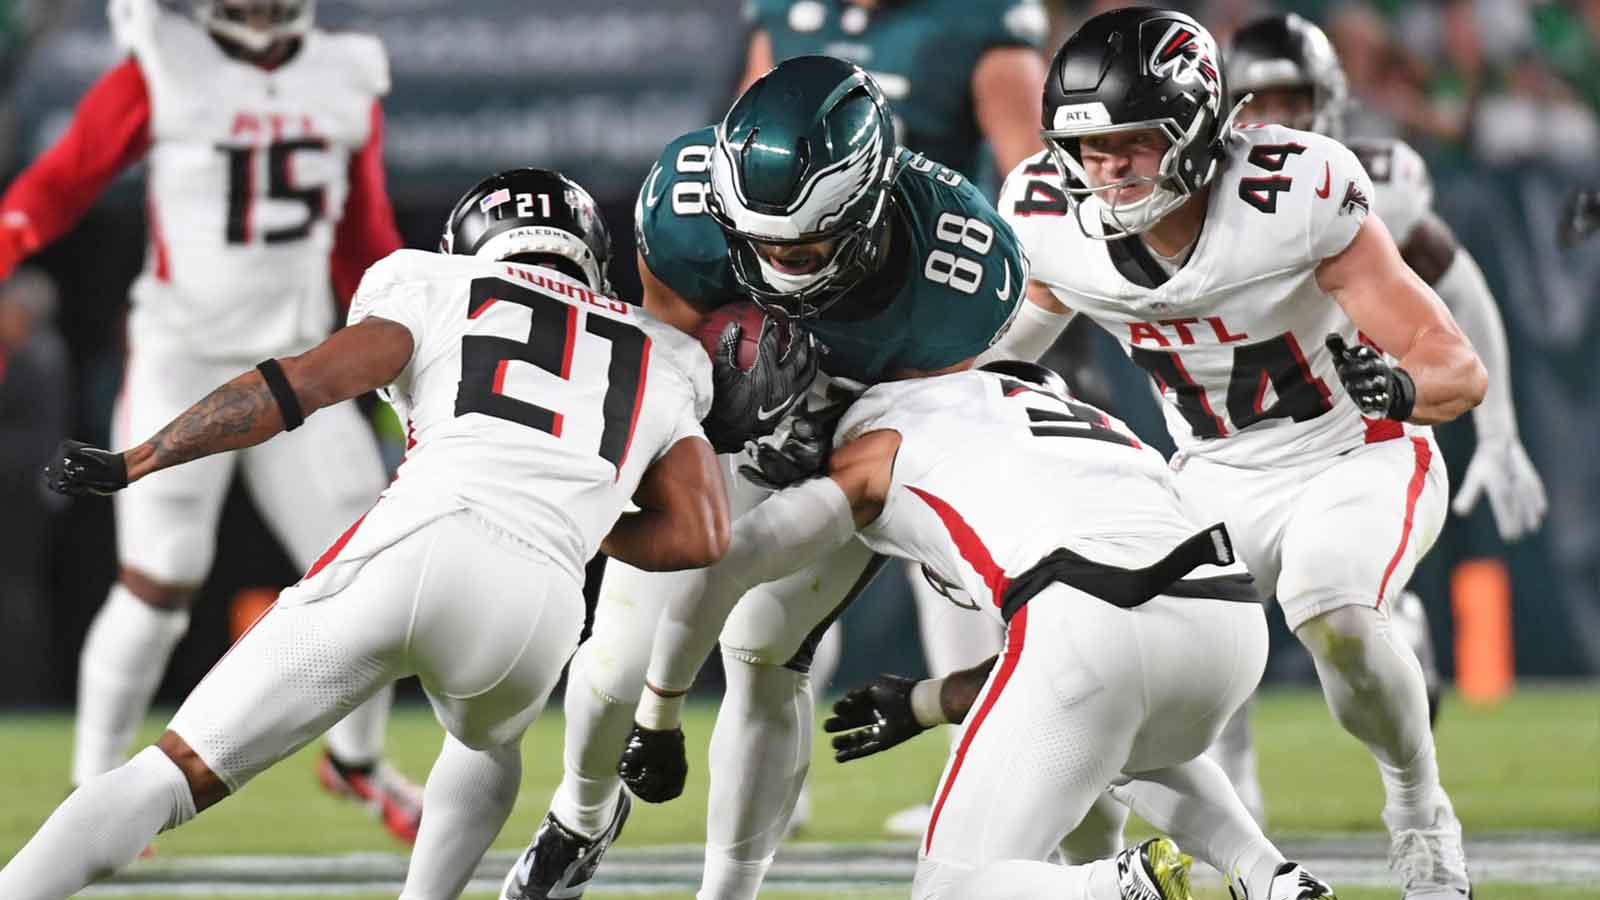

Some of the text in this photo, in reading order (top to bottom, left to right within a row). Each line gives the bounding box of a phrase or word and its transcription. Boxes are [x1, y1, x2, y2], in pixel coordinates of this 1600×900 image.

[1066, 111, 1092, 120] ATL
[214, 137, 330, 245] 15
[516, 193, 551, 218] 21
[1239, 142, 1308, 214] 44
[924, 212, 994, 295] 88
[1125, 316, 1249, 347] ATL
[454, 276, 652, 482] 21
[1130, 330, 1334, 440] 44
